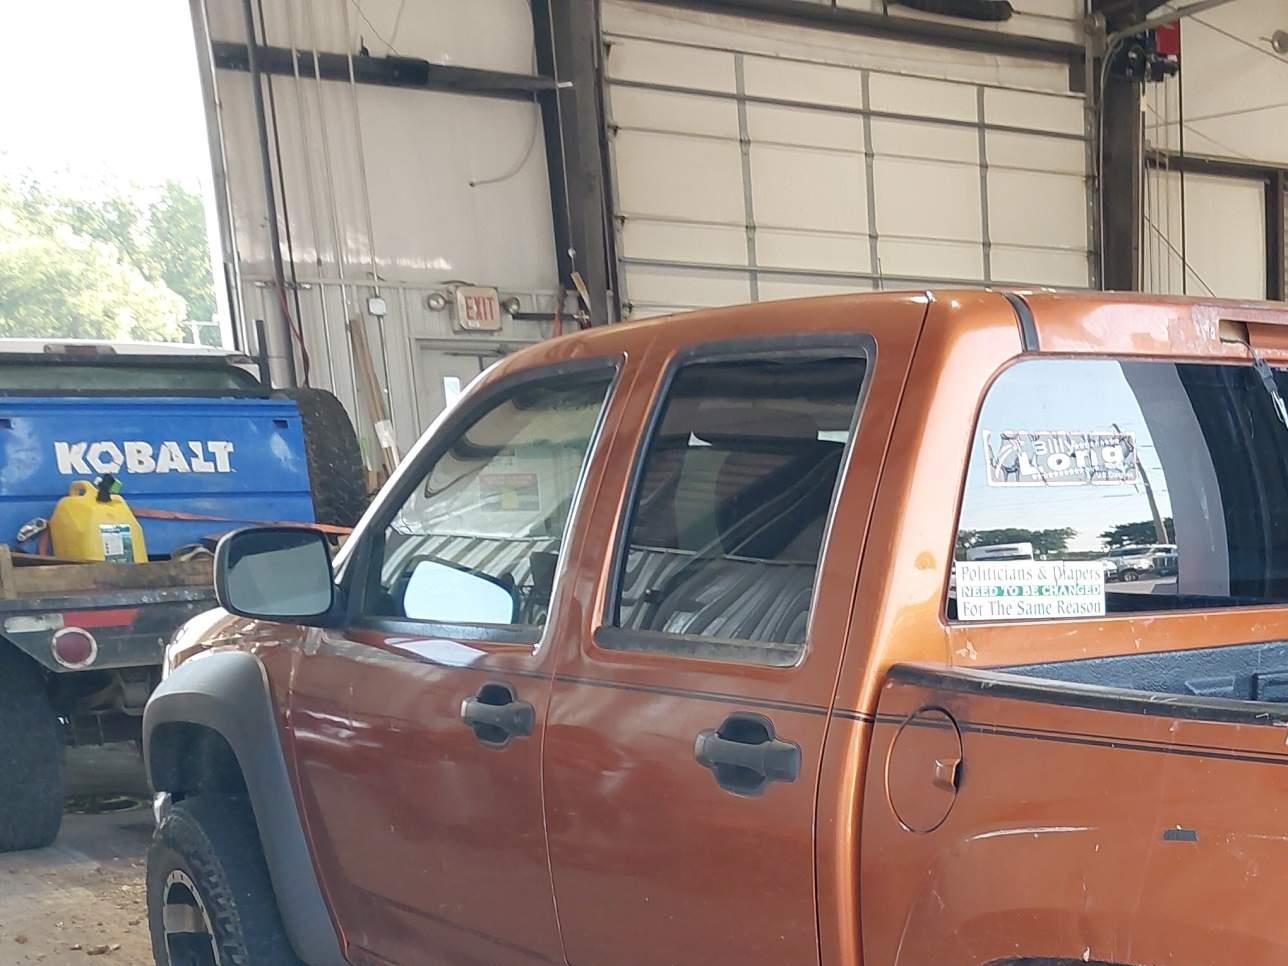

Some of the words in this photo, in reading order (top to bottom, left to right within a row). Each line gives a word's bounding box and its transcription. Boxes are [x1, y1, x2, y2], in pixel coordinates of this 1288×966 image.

[465, 295, 494, 320] EXIT
[54, 441, 235, 474] KOBALT
[1019, 446, 1124, 475] Long
[961, 565, 1033, 582] Politicians
[1037, 566, 1048, 580] &
[1052, 565, 1101, 584] Diapers
[961, 586, 998, 597] NEED
[1003, 586, 1018, 597] TO
[1023, 585, 1039, 597] BE
[1041, 585, 1100, 597] CHANGED
[962, 601, 983, 617] For
[988, 600, 1014, 616] The
[1017, 600, 1055, 616] Same
[1057, 599, 1101, 615] Reason
